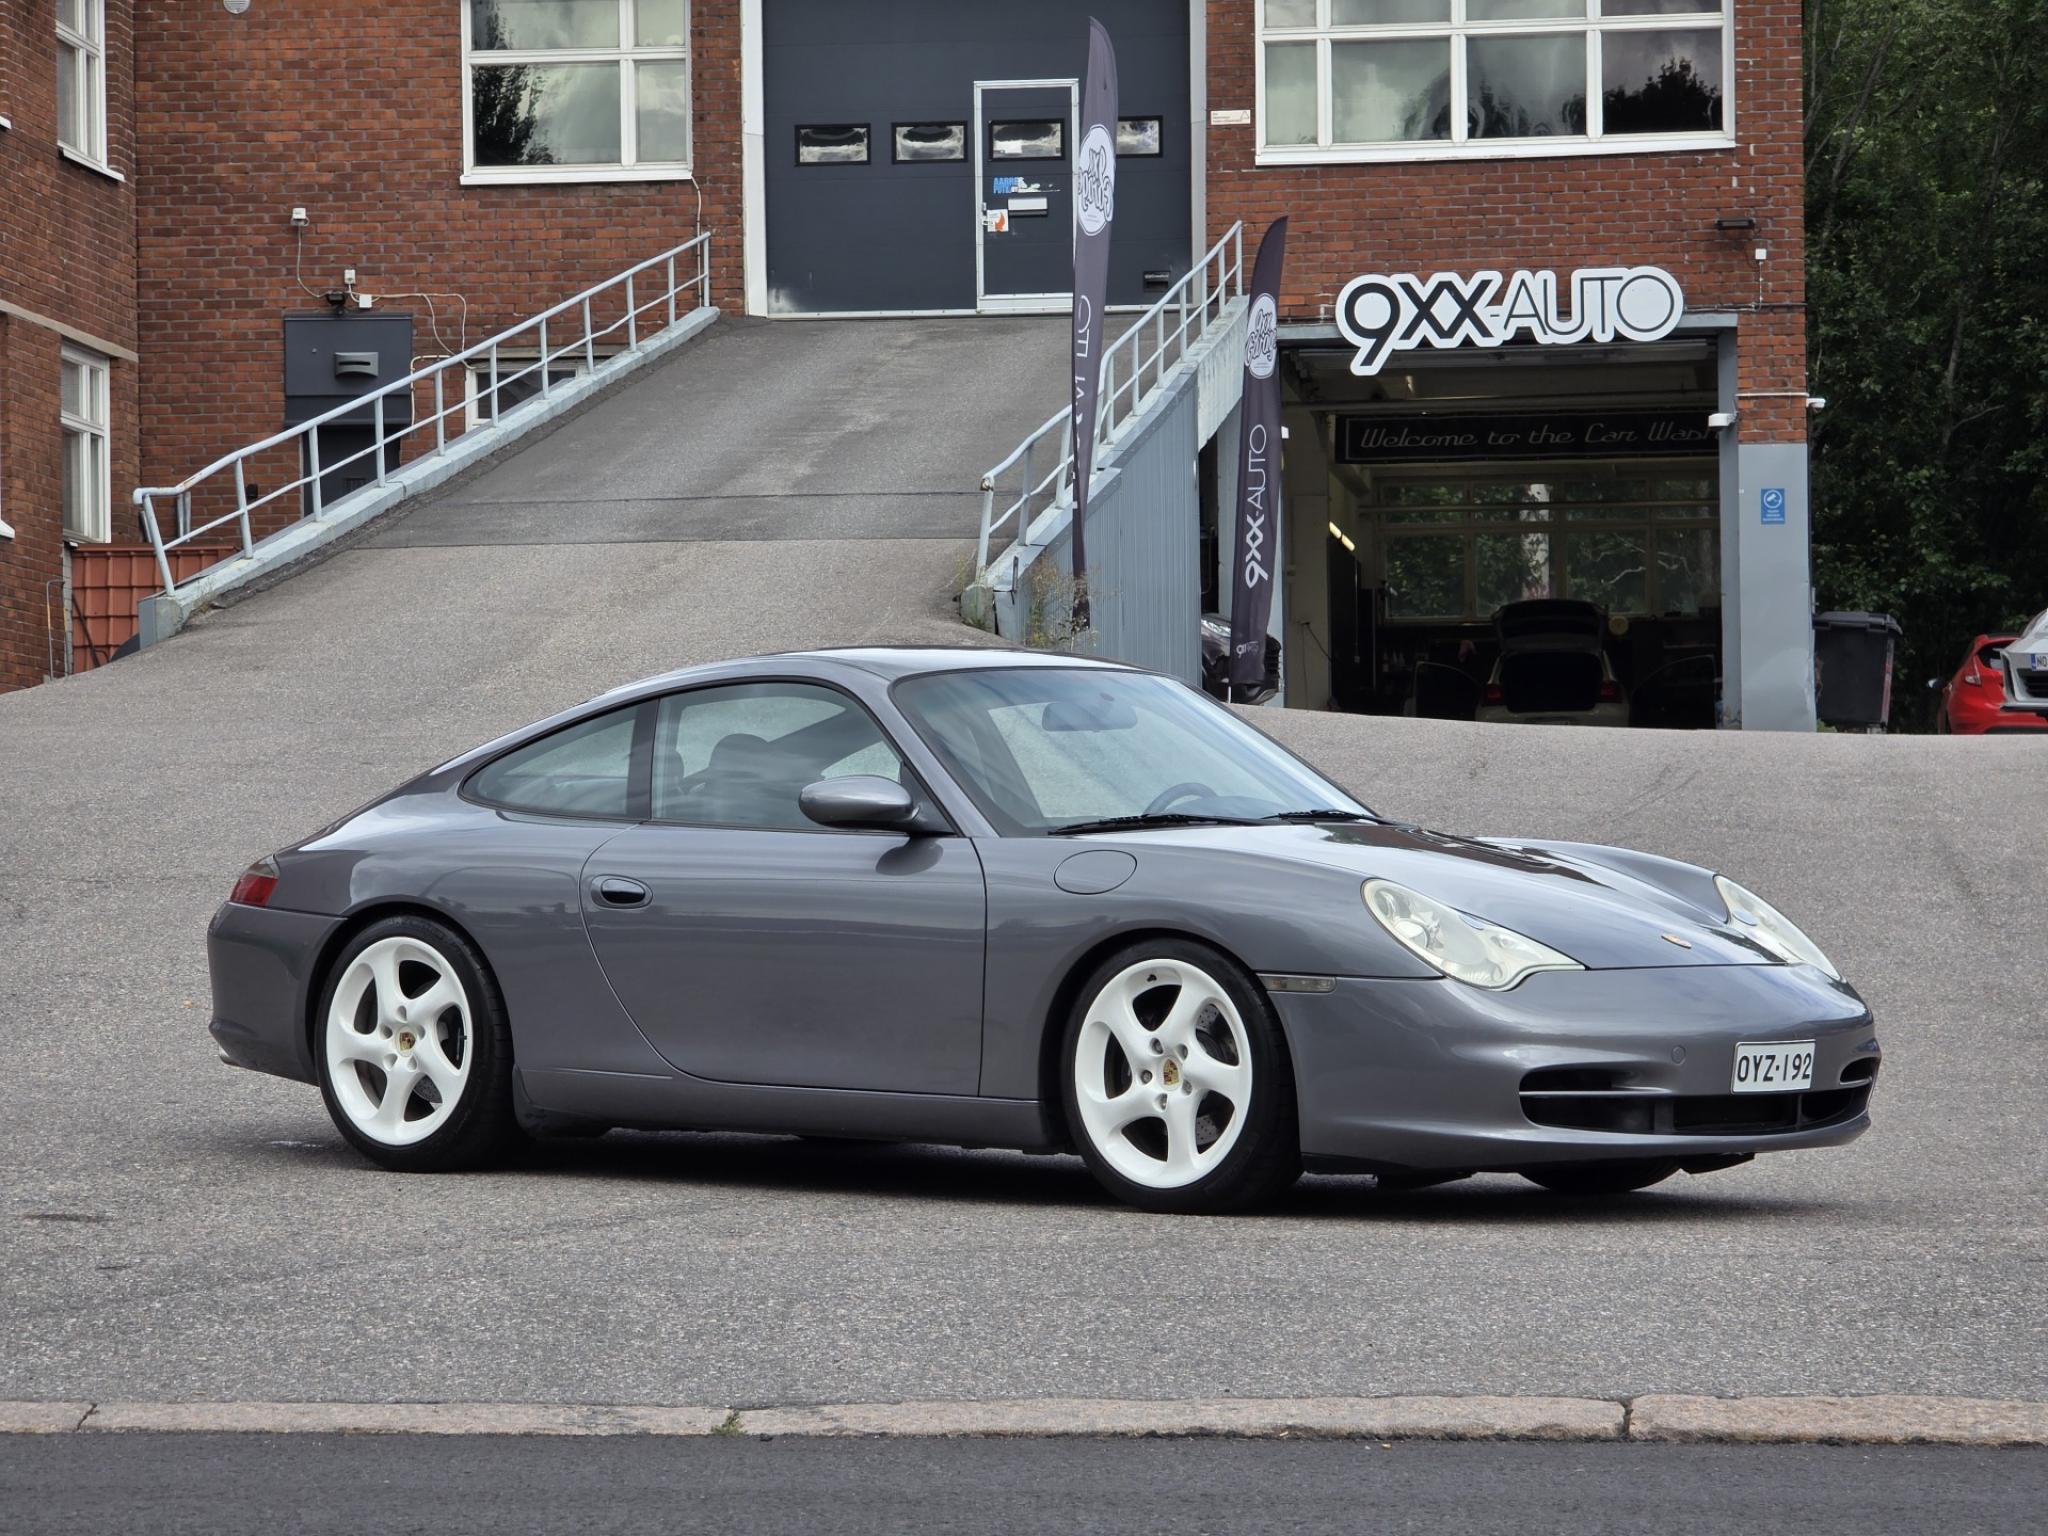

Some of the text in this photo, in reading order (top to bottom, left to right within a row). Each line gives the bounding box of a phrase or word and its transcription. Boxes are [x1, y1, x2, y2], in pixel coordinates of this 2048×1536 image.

[1342, 271, 1678, 370] 9XX-AUTO
[1360, 426, 1478, 449] Welcome
[1487, 430, 1520, 446] to
[1528, 423, 1576, 445] the
[1584, 421, 1638, 443] Car
[1244, 423, 1269, 589] 9XX-AUTO
[1737, 1053, 1812, 1083] OYZ-192
